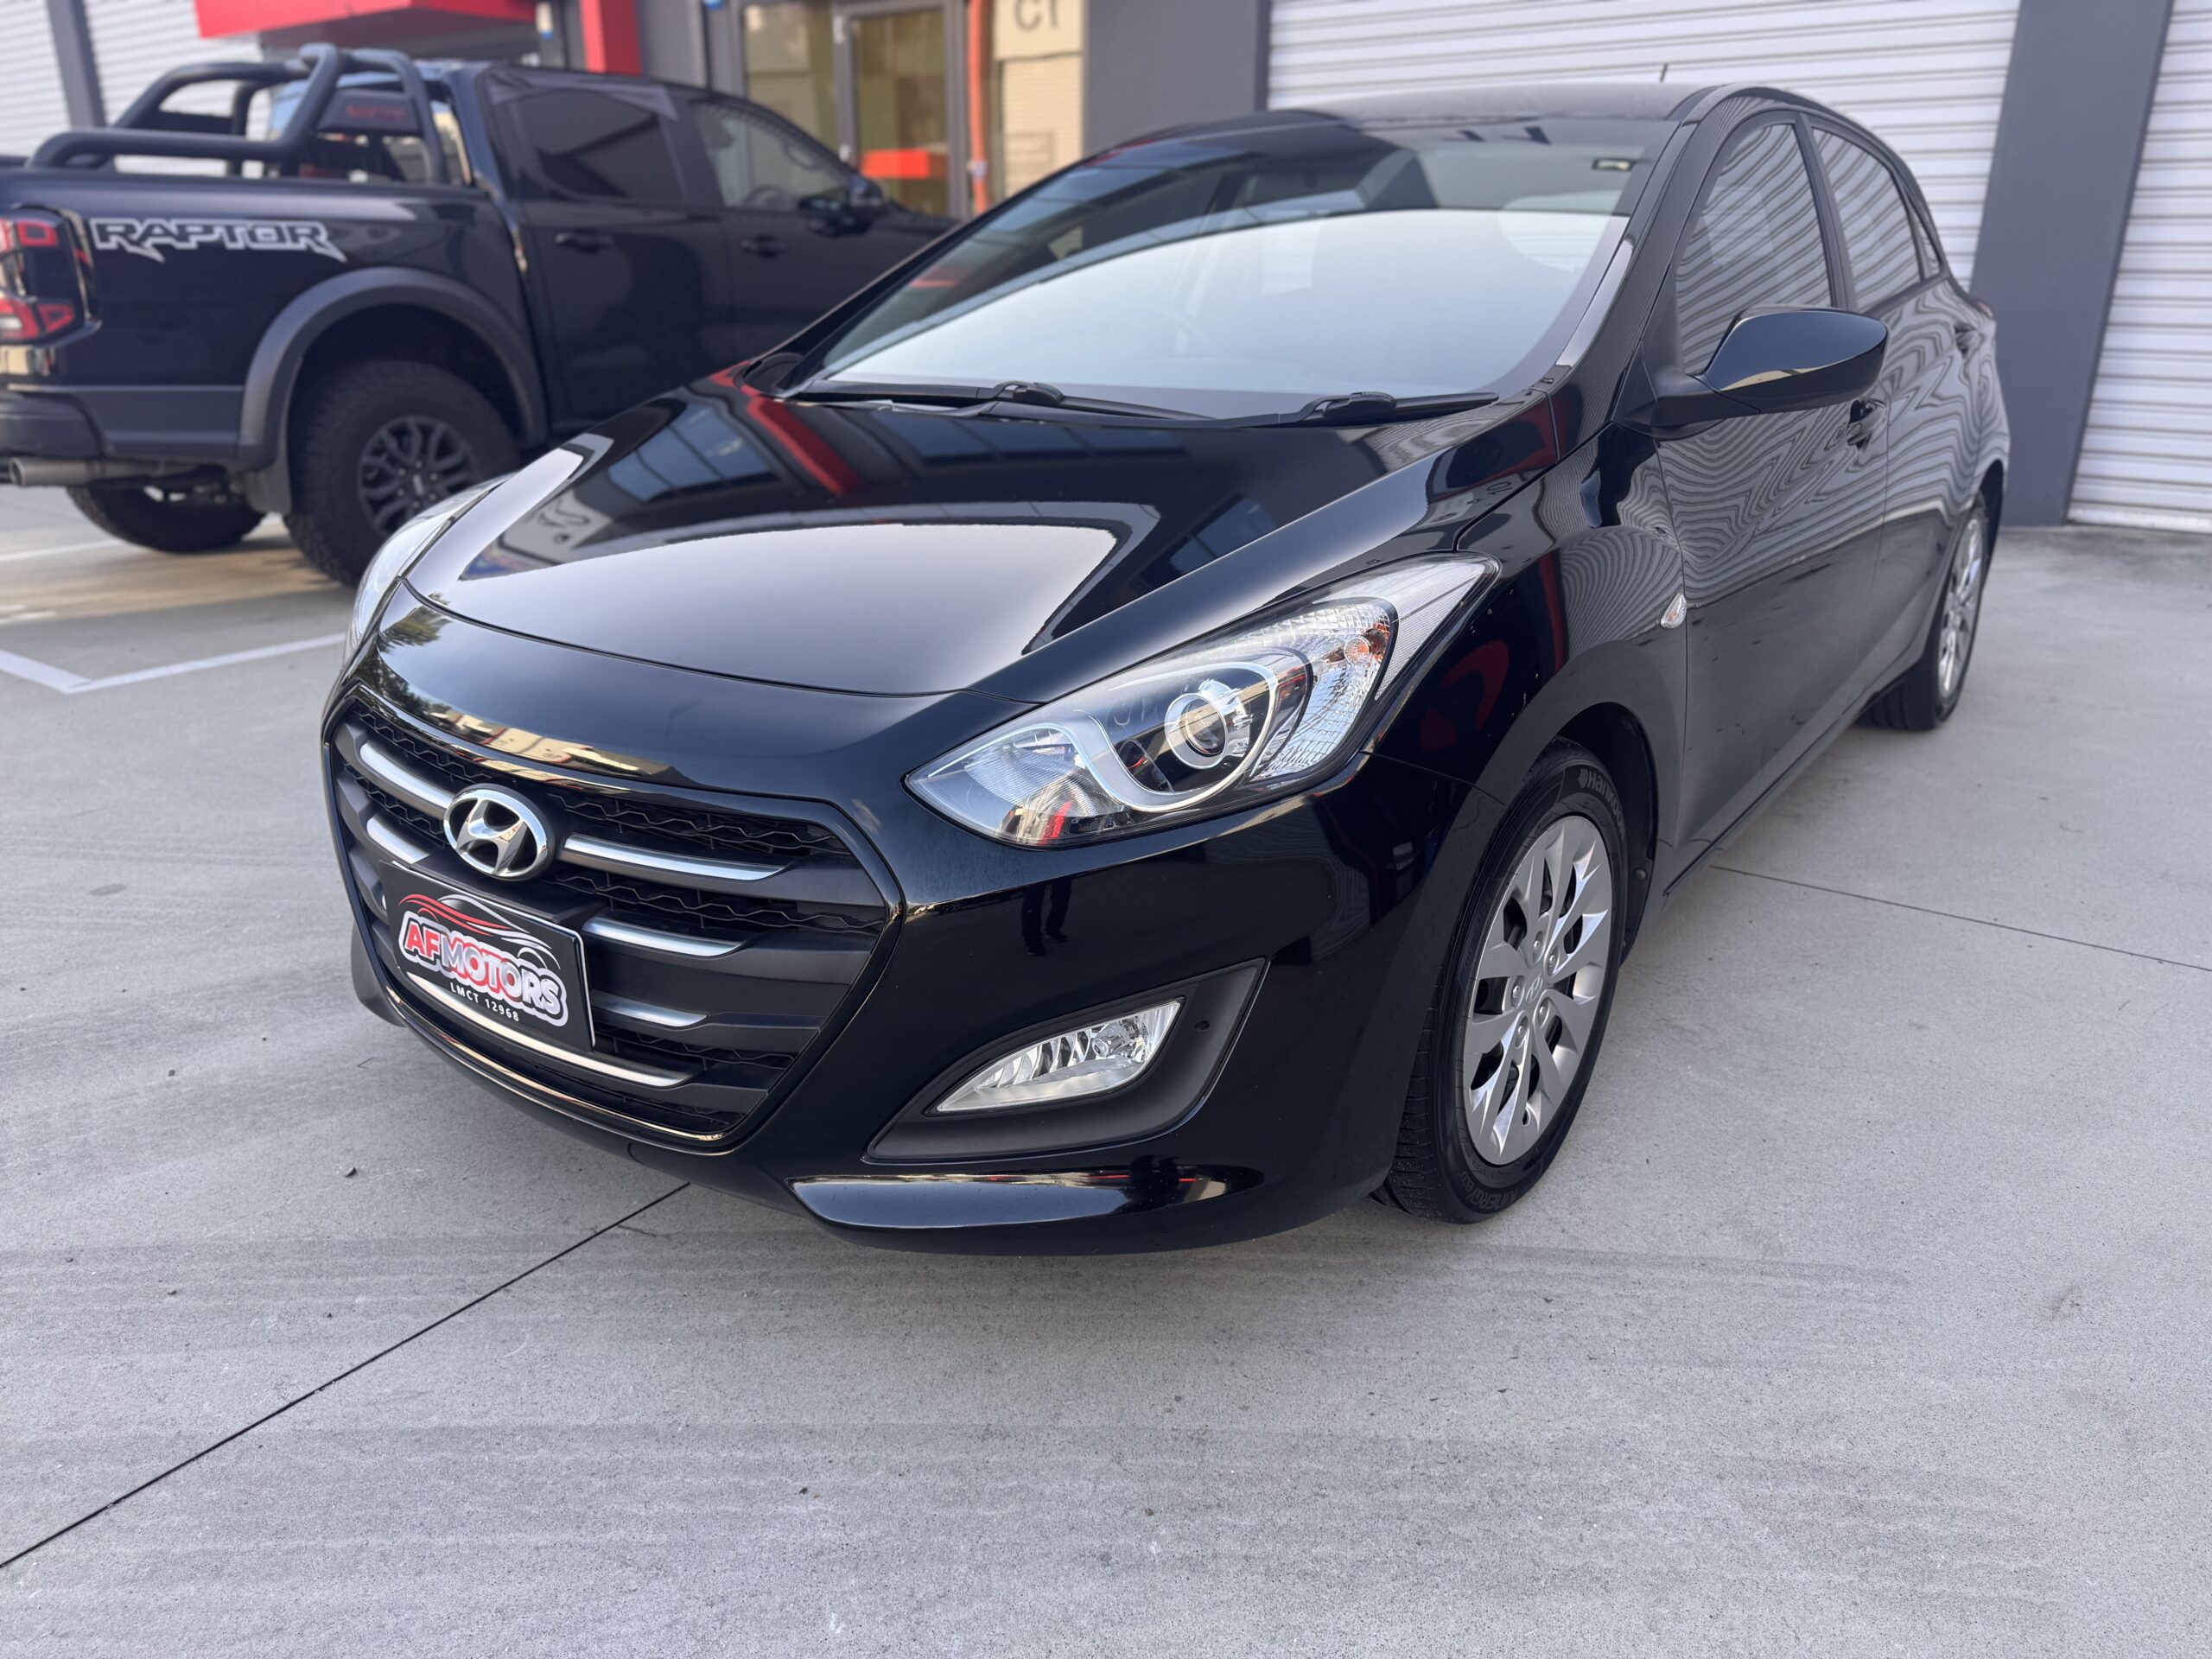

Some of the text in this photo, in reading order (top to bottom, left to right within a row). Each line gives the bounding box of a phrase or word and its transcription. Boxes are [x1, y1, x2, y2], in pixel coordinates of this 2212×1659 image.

[89, 219, 347, 263] RAPTOR
[450, 982, 519, 1022] LMCT 12968
